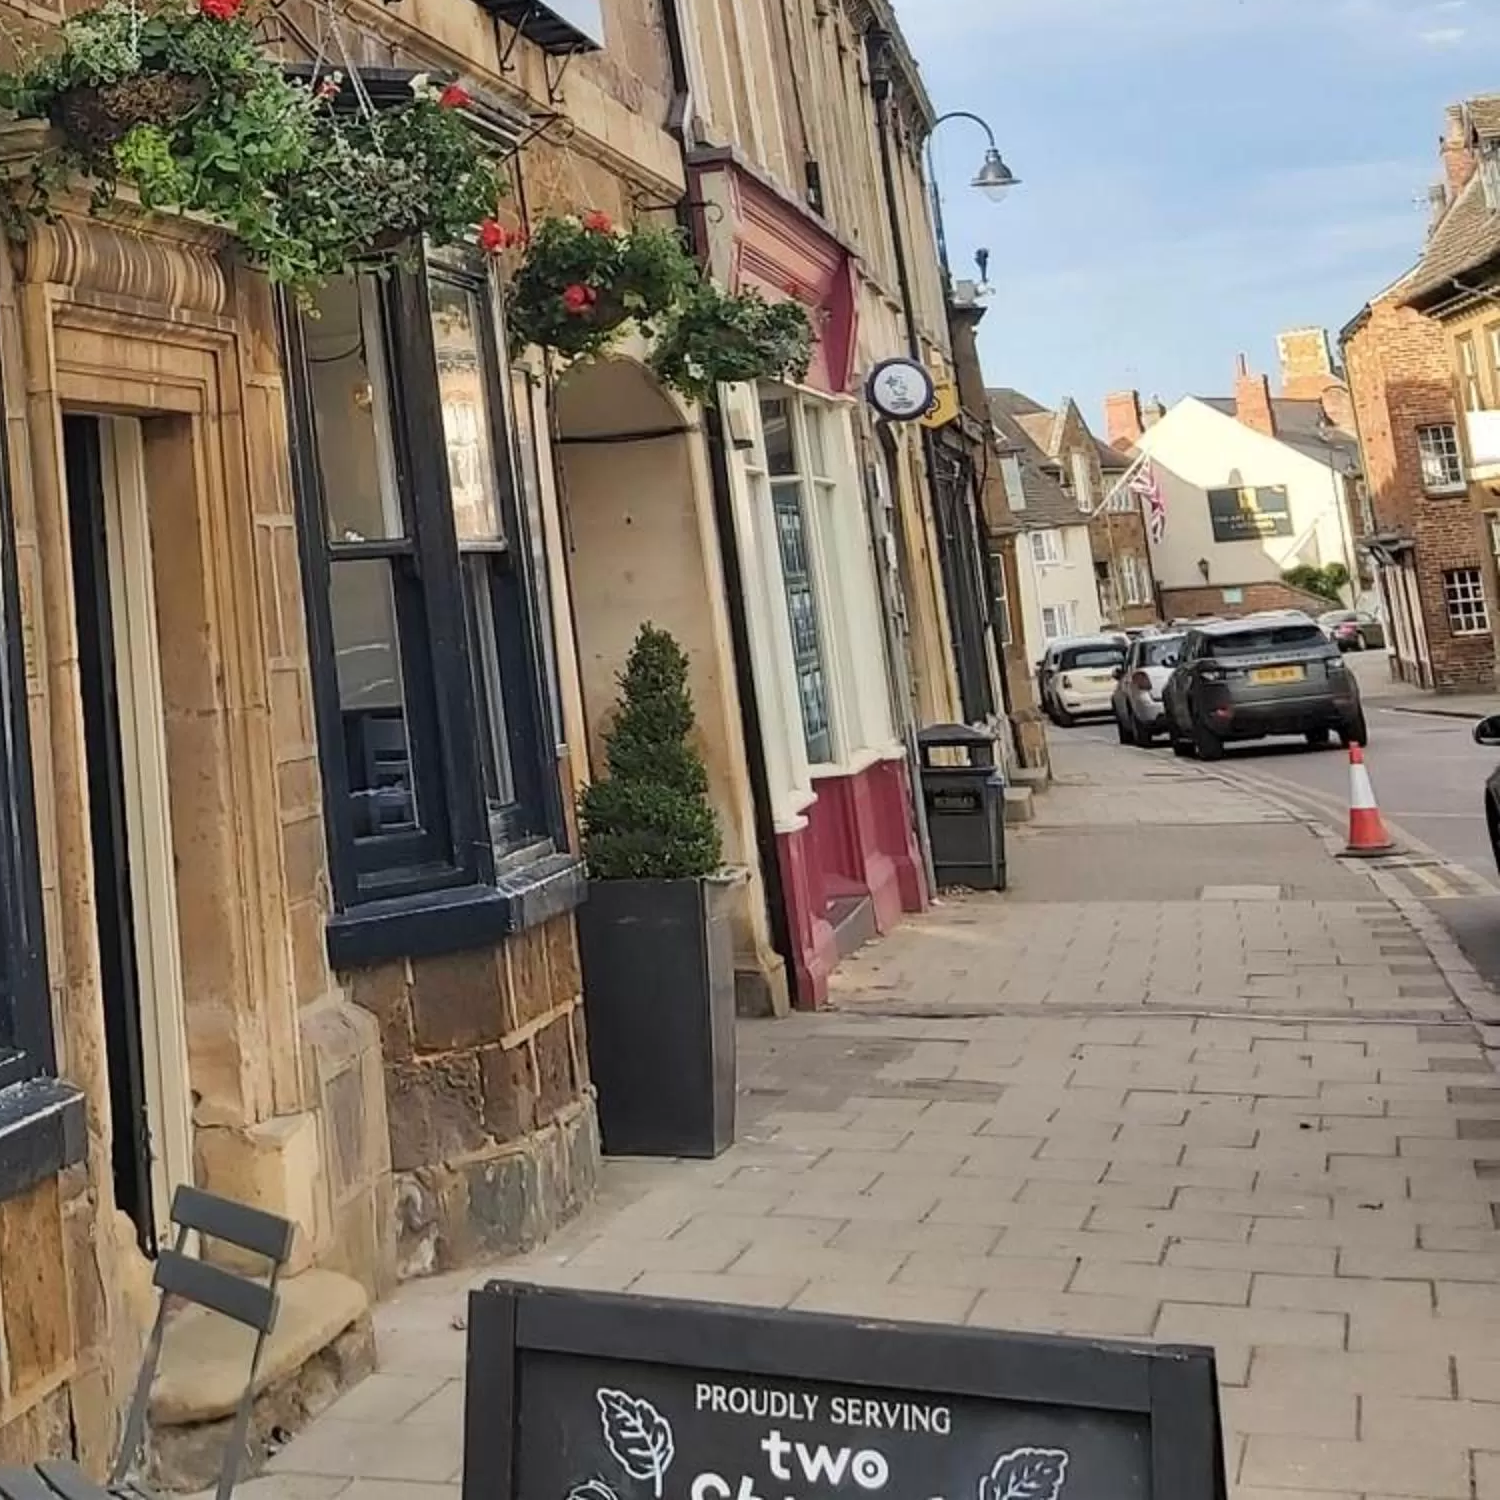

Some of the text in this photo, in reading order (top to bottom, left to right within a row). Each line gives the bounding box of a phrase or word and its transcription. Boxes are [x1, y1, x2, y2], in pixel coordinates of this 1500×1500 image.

[695, 1382, 952, 1435] PROUDLY SERVING
[760, 1429, 890, 1490] two
